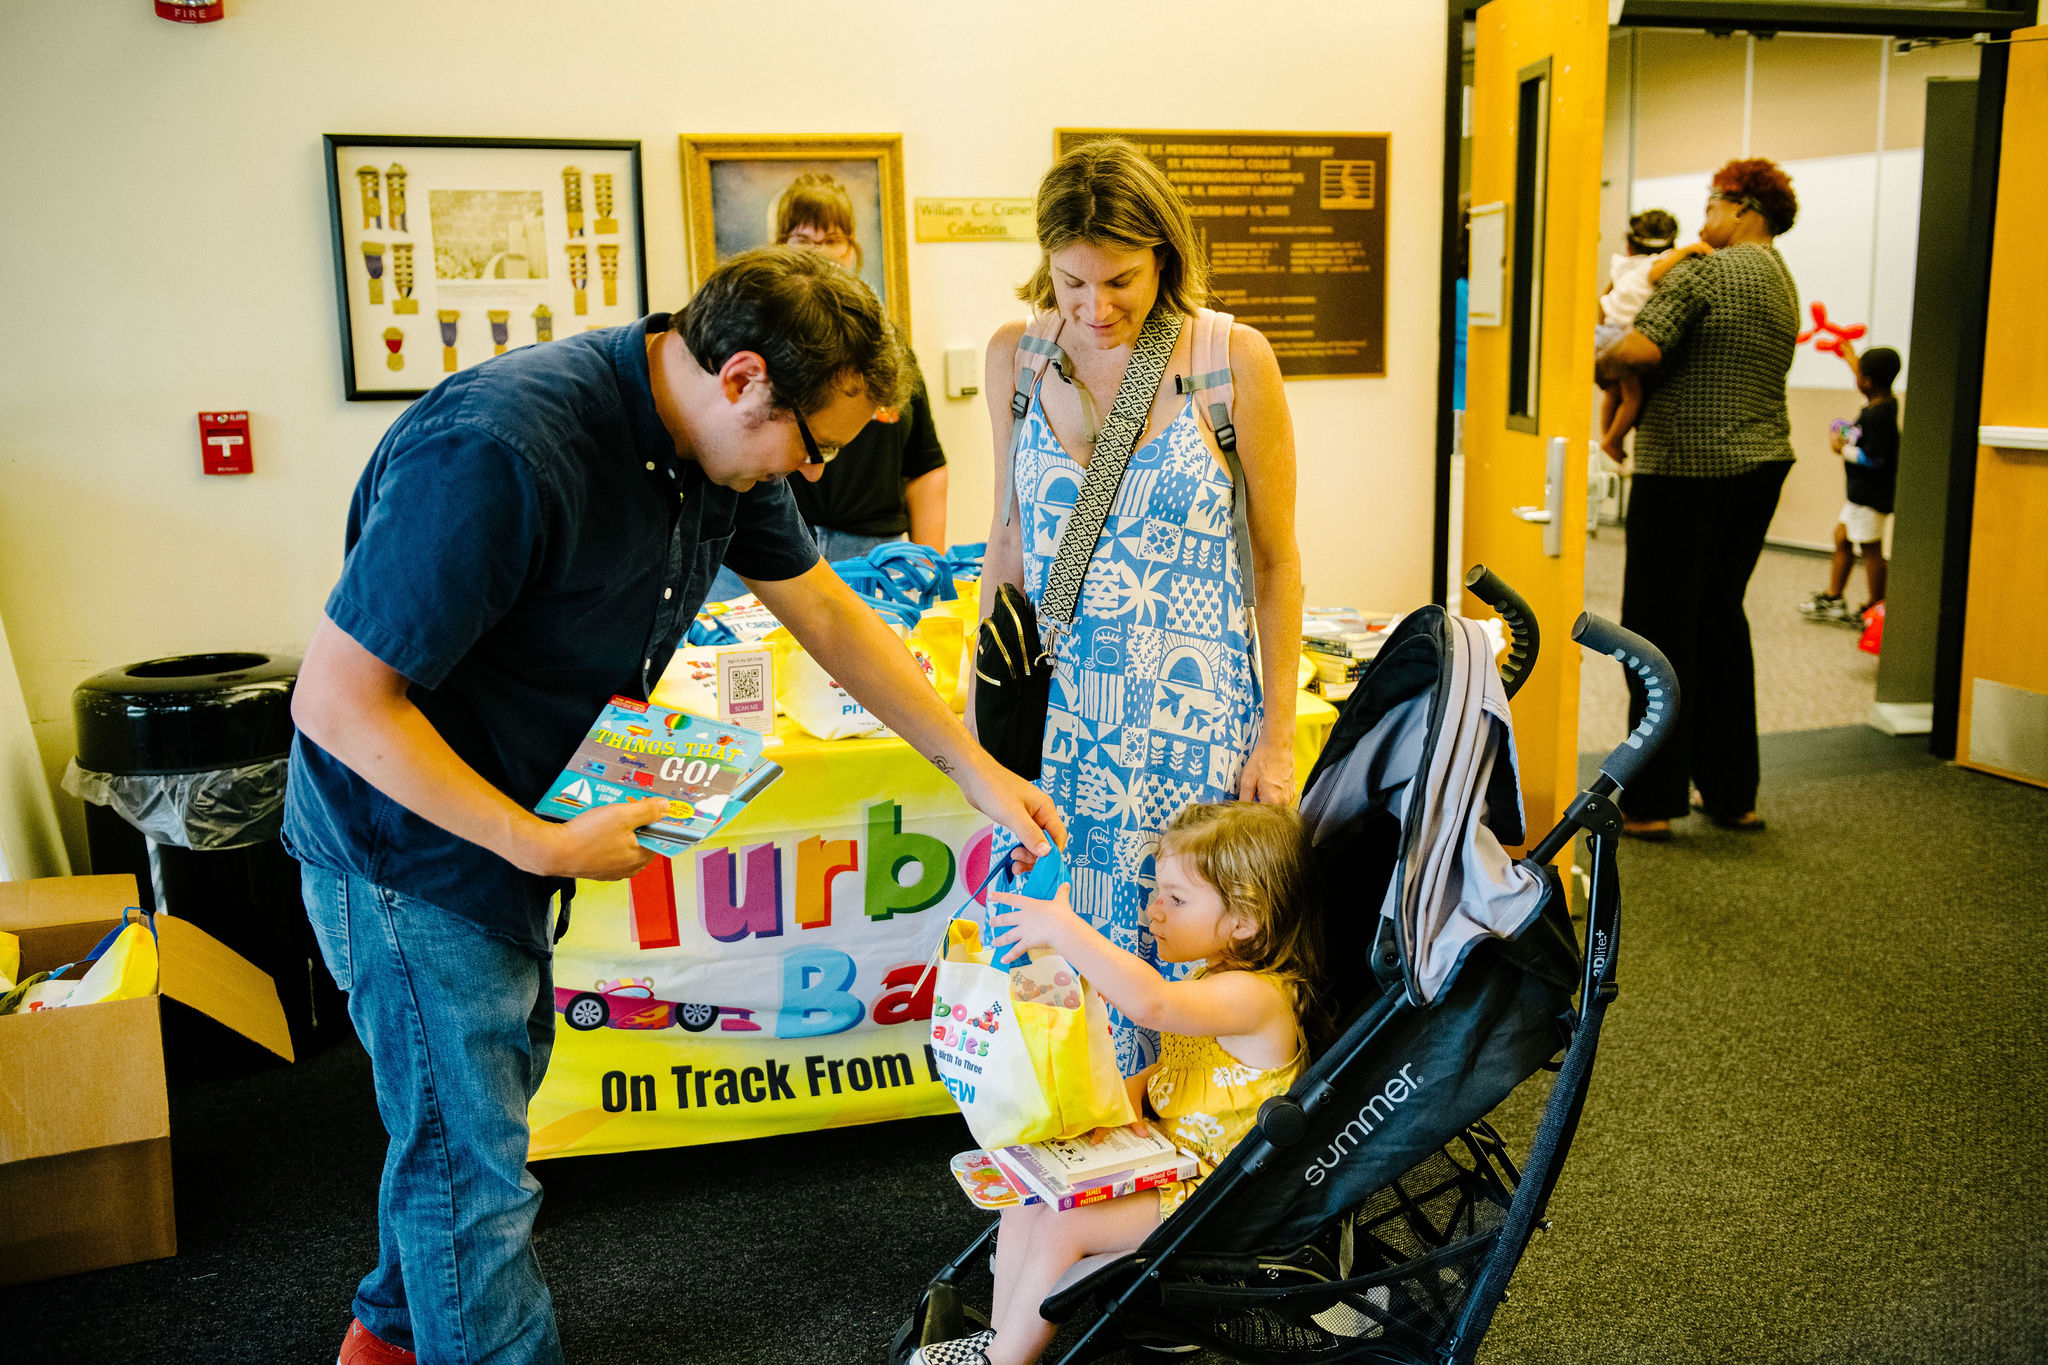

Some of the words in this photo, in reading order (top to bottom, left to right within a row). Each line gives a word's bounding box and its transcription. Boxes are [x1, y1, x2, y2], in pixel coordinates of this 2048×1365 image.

[174, 8, 207, 19] FIRE
[921, 202, 964, 217] William
[947, 221, 1007, 236] Collection
[734, 705, 750, 713] SCAN
[595, 729, 676, 756] THINGS
[684, 743, 743, 763] THAT
[659, 756, 721, 787] GO!
[933, 995, 967, 1022] bo
[932, 1025, 990, 1057] abies
[938, 1049, 953, 1063] Birth
[954, 1056, 963, 1067] To
[963, 1059, 983, 1075] Three
[601, 1070, 657, 1113] On
[671, 1059, 796, 1109] Track
[805, 1053, 915, 1097] From
[1080, 1194, 1107, 1206] PATTERSON
[1085, 1187, 1102, 1197] JAMES
